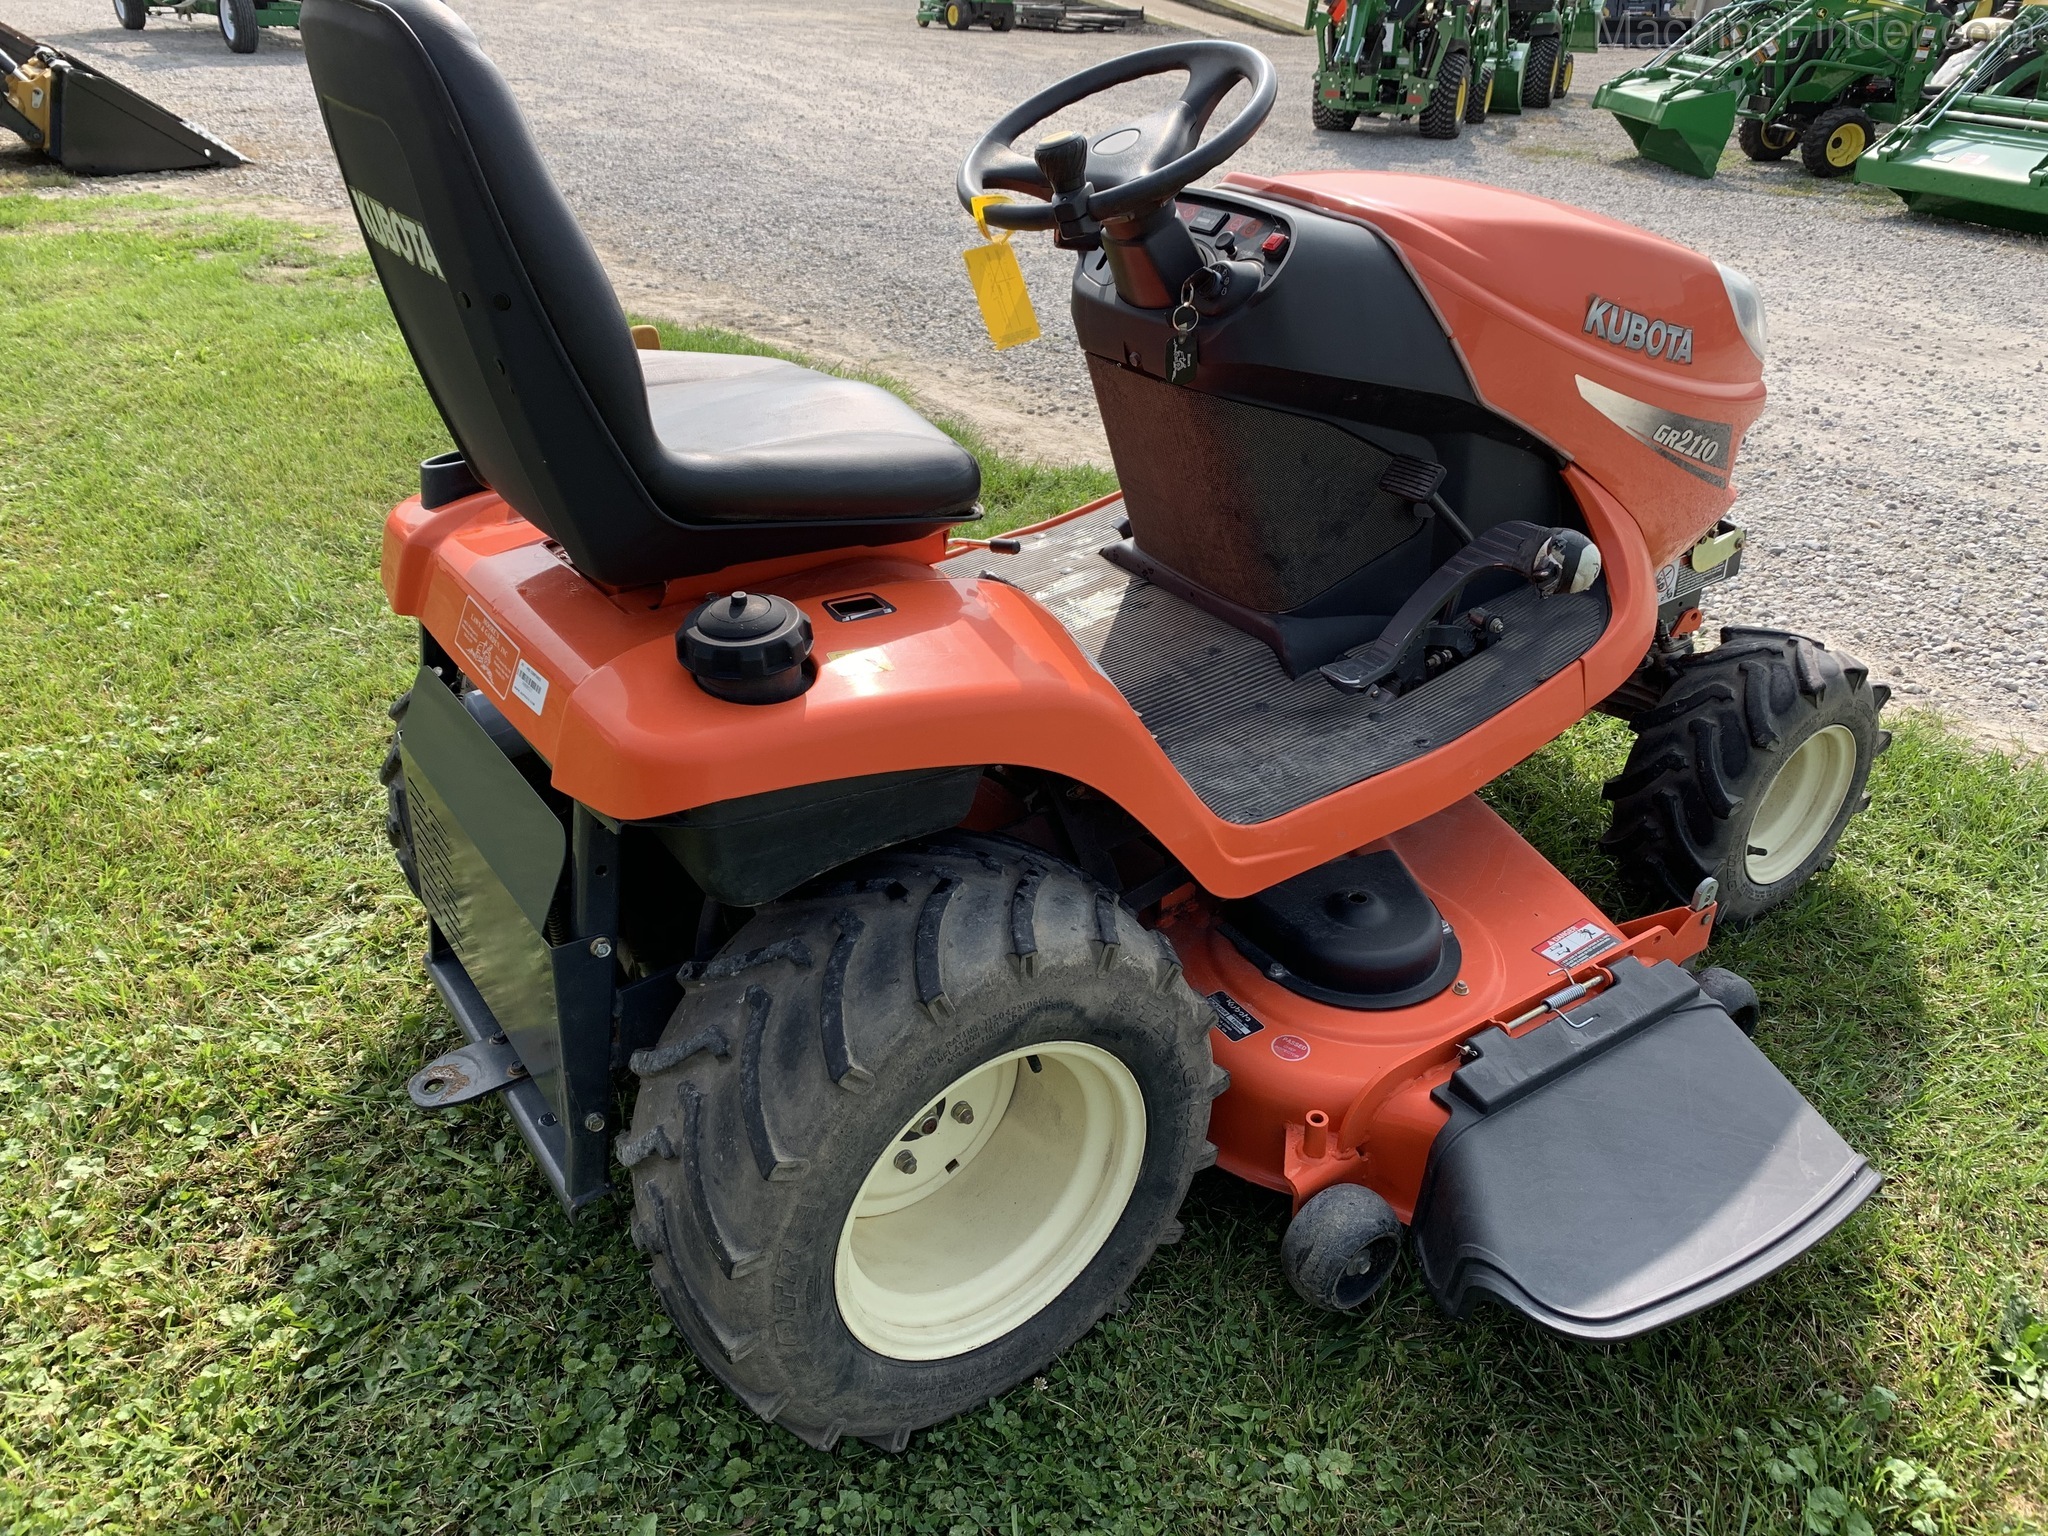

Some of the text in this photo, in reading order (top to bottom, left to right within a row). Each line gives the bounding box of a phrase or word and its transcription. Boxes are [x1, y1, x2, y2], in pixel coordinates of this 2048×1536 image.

[348, 185, 447, 283] KUBOTA
[1583, 294, 1693, 364] KUBOTA
[1652, 424, 1719, 463] GR2110
[1226, 998, 1252, 1022] Kubota
[945, 1024, 979, 1048] RATING
[1282, 1036, 1307, 1051] PASSED
